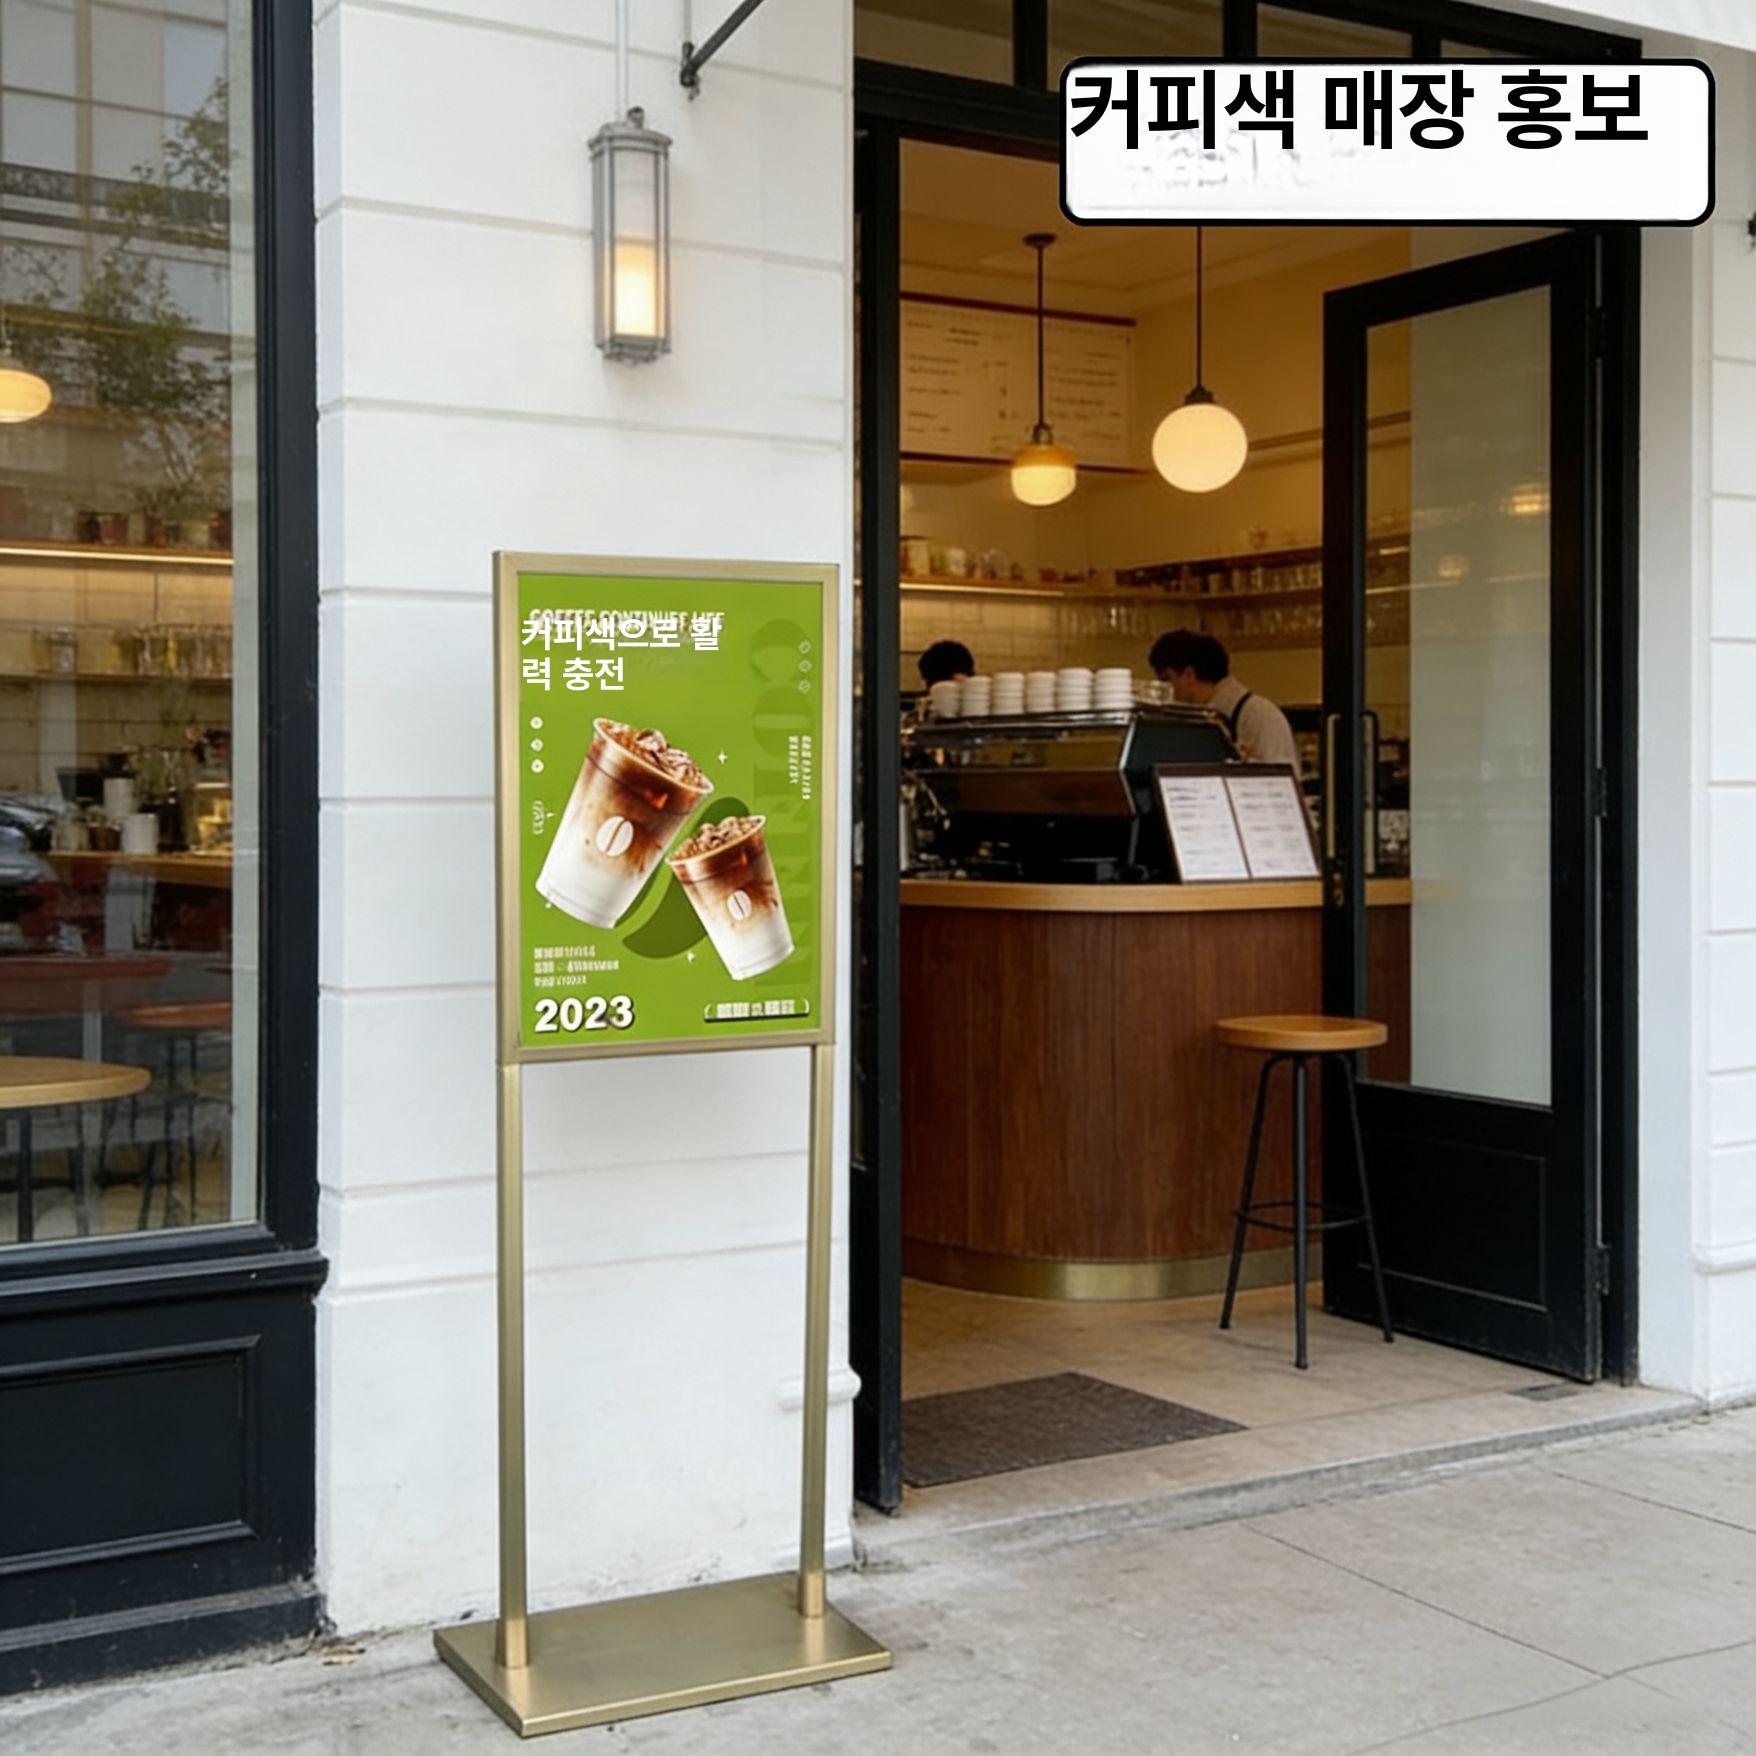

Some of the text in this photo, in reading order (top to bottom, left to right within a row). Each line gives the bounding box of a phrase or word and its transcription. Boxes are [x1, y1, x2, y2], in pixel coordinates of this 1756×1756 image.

[521, 616, 722, 651] 커피색으로 활
[522, 657, 625, 691] 력 충전
[534, 995, 634, 1032] 2023
